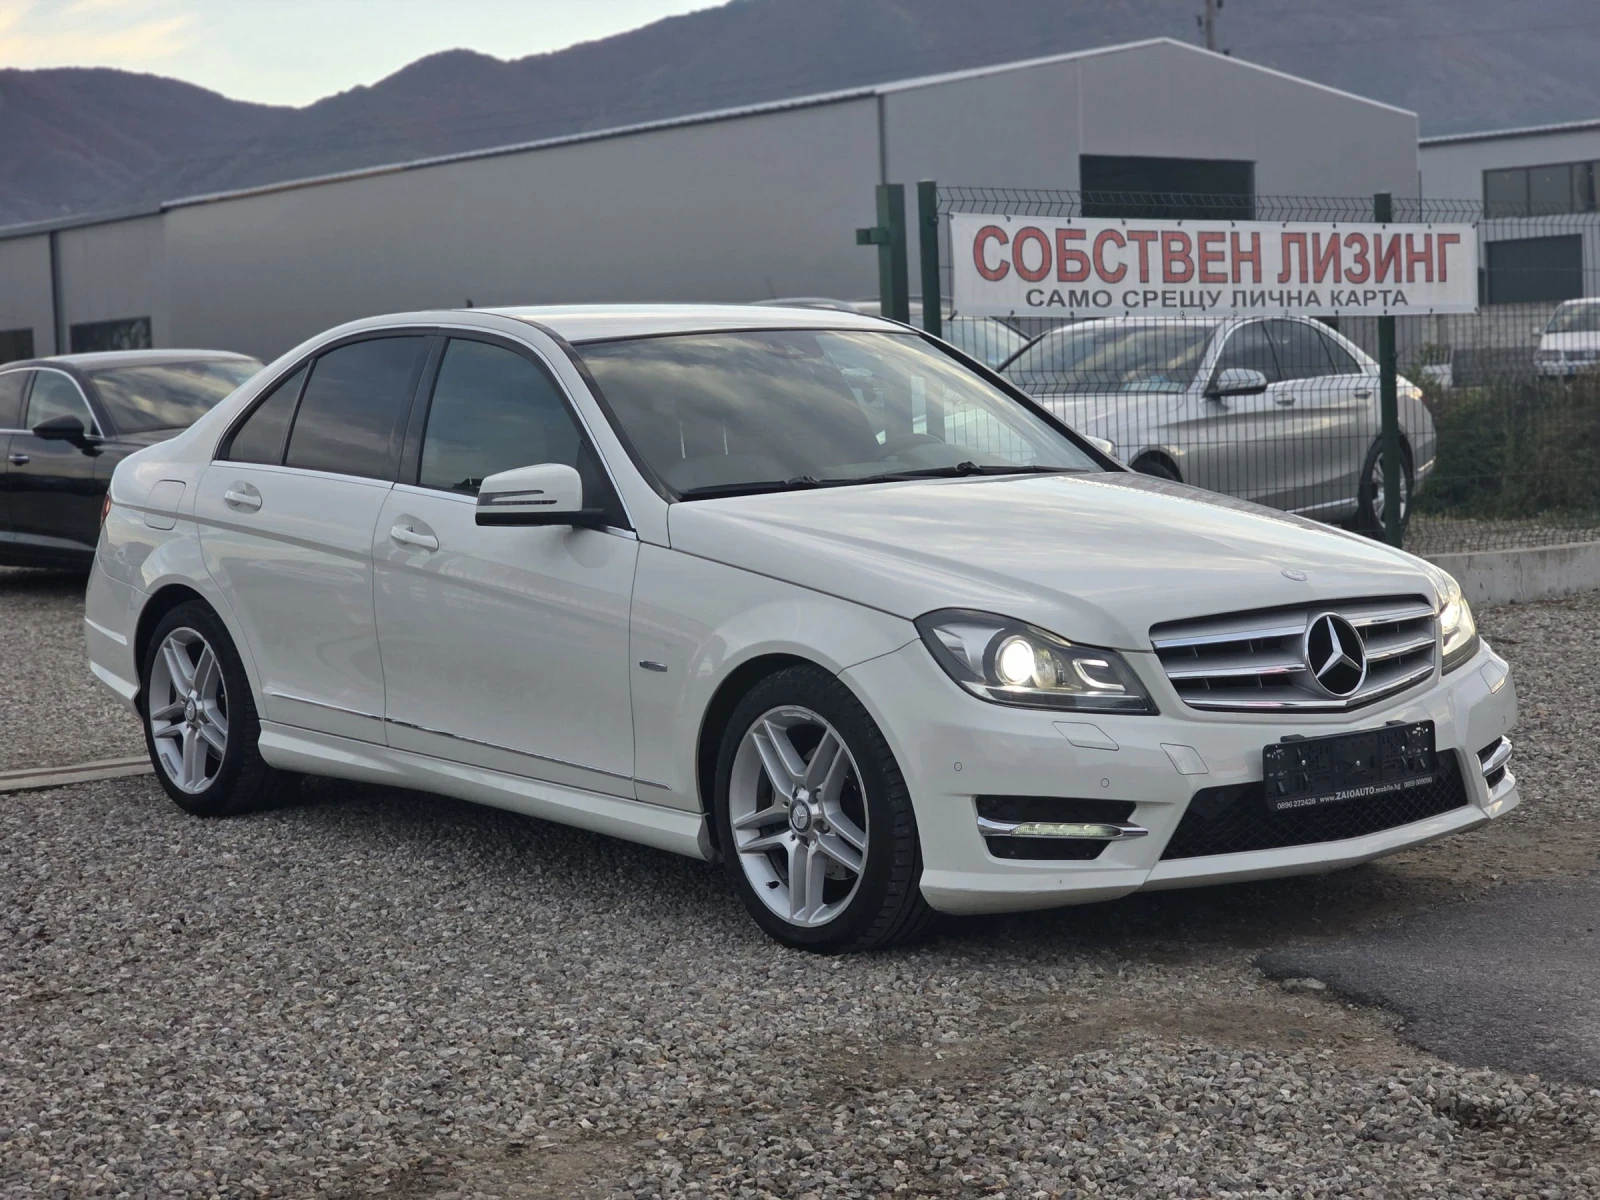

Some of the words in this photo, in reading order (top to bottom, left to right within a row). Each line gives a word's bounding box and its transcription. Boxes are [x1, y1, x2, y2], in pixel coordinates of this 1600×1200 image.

[972, 224, 1260, 284] СОБСТВЕН
[1277, 231, 1461, 284] ЛИЗИНГ
[1025, 289, 1113, 308] САМО
[1121, 289, 1222, 311] СРЕЩУ
[1230, 290, 1323, 308] ЛИЧНА
[1330, 290, 1409, 308] КАРТА
